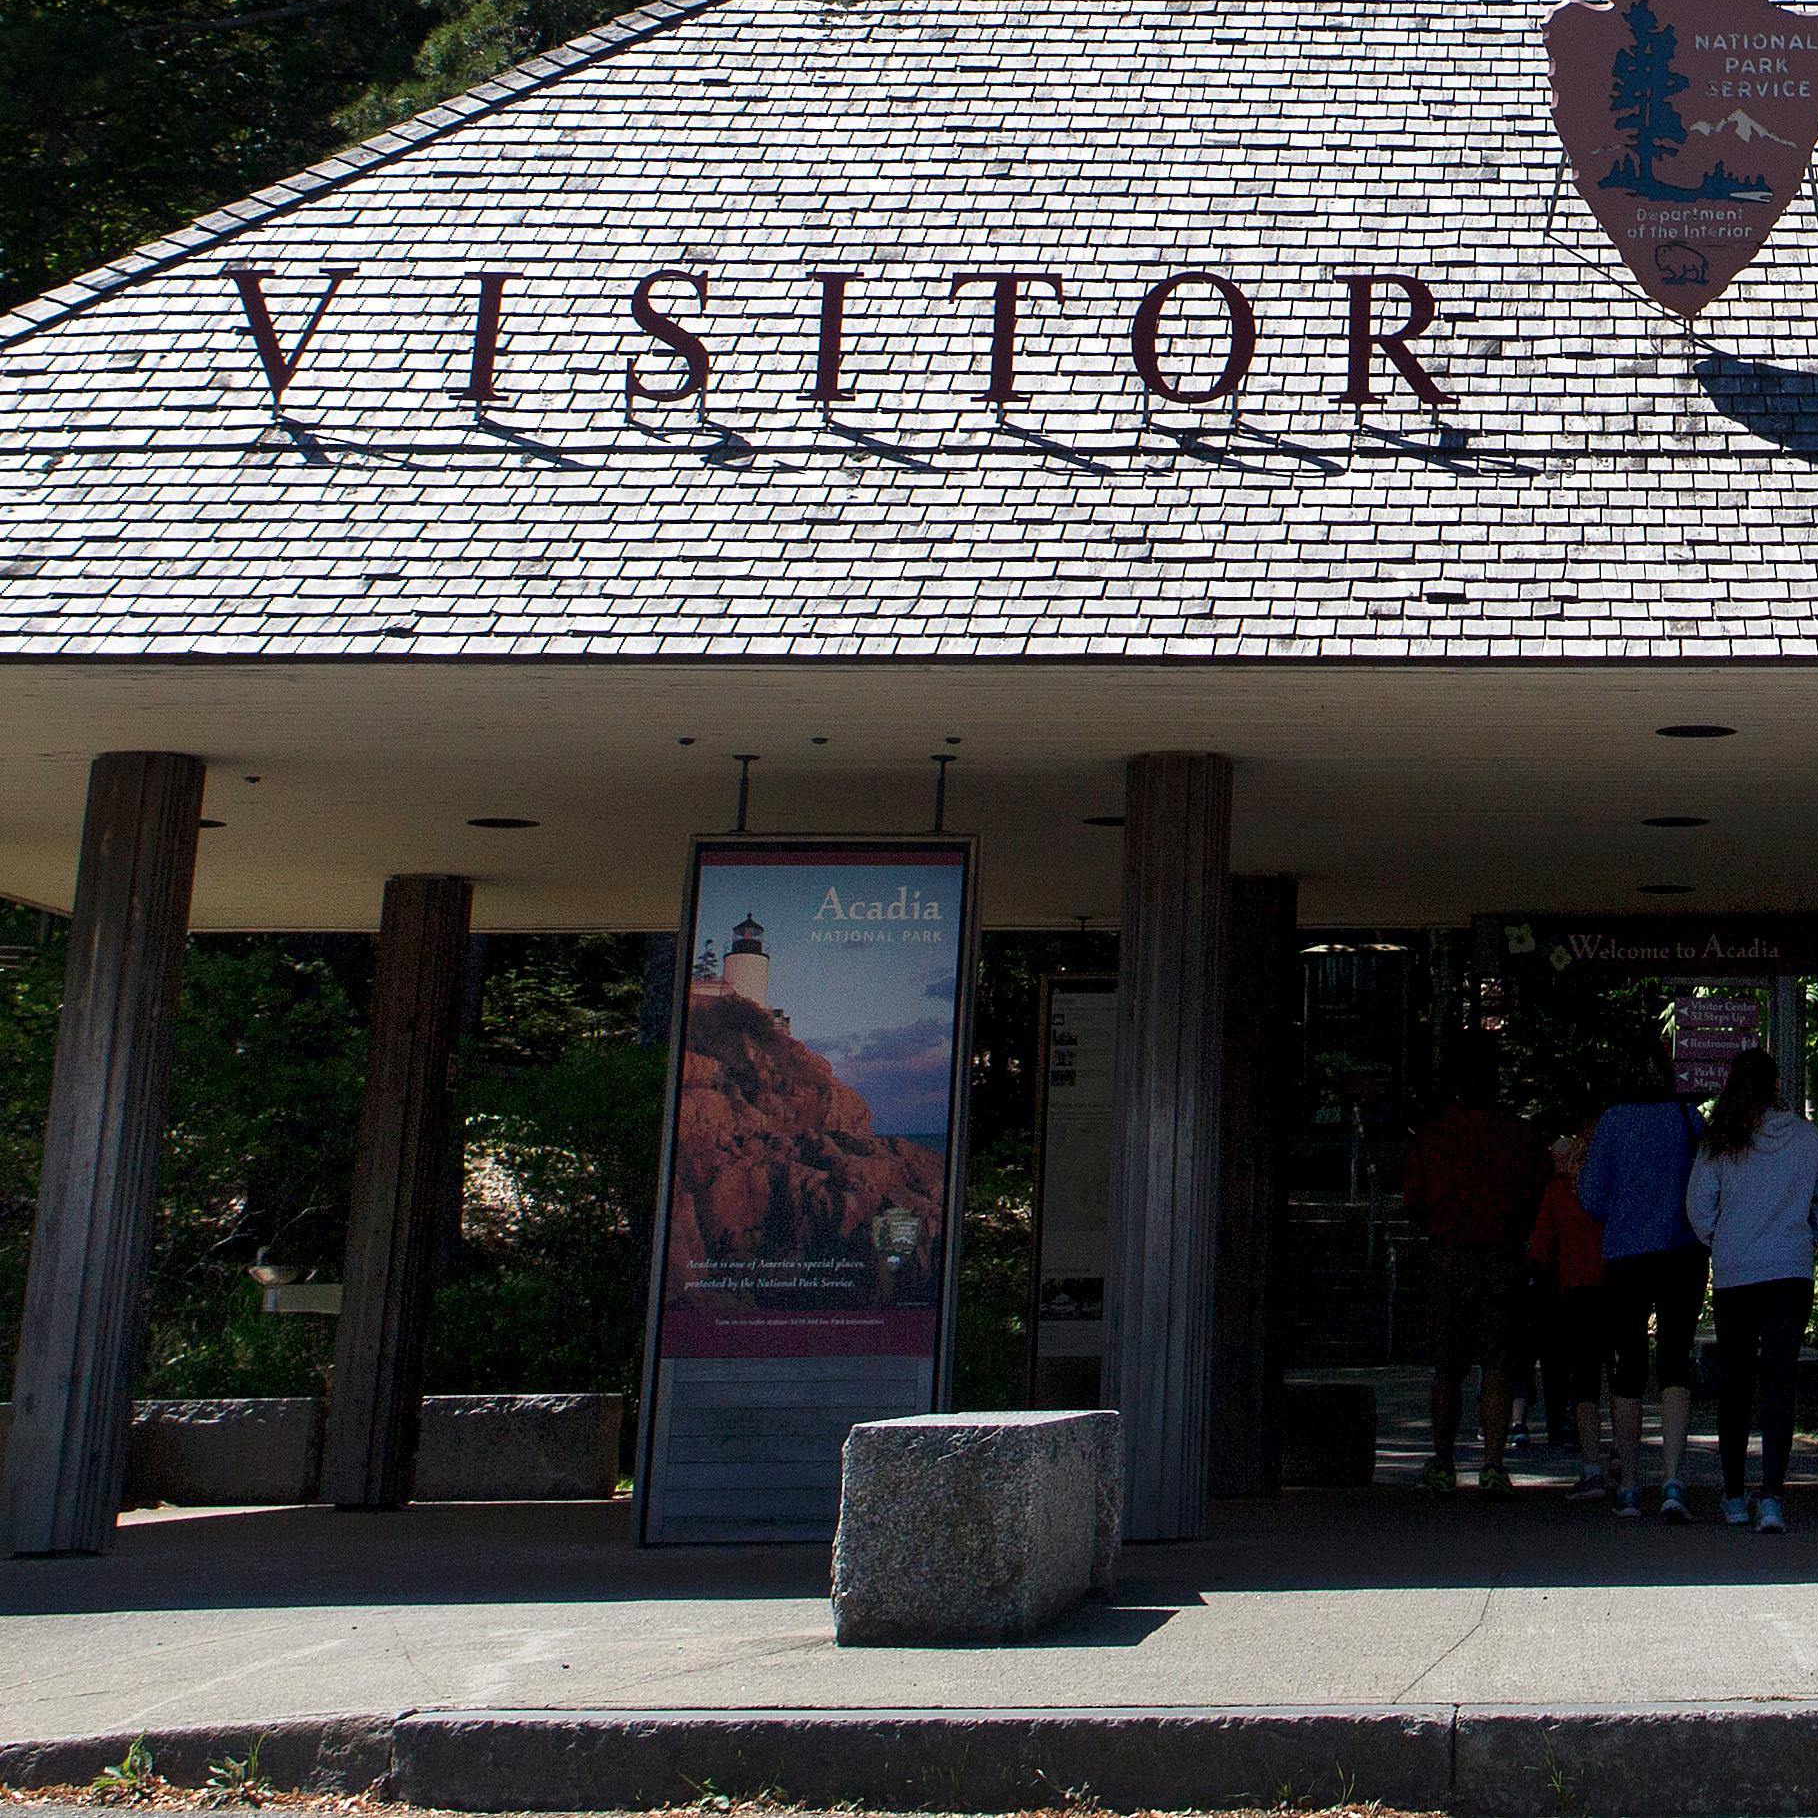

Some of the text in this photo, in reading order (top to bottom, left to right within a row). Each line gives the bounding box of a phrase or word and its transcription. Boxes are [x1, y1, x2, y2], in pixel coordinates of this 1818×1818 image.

[1694, 33, 1818, 52] NATIONAL
[1724, 56, 1789, 74] PARK
[1704, 80, 1812, 99] SERVICE
[1636, 207, 1744, 223] Department
[1627, 223, 1754, 239] of the Interior
[223, 268, 1458, 406] VISITOR
[811, 885, 944, 921] Acadia
[810, 930, 943, 943] NATIONAL PARK
[1567, 932, 1781, 960] Welcome to Acadia
[1691, 999, 1758, 1012] Visitor Center
